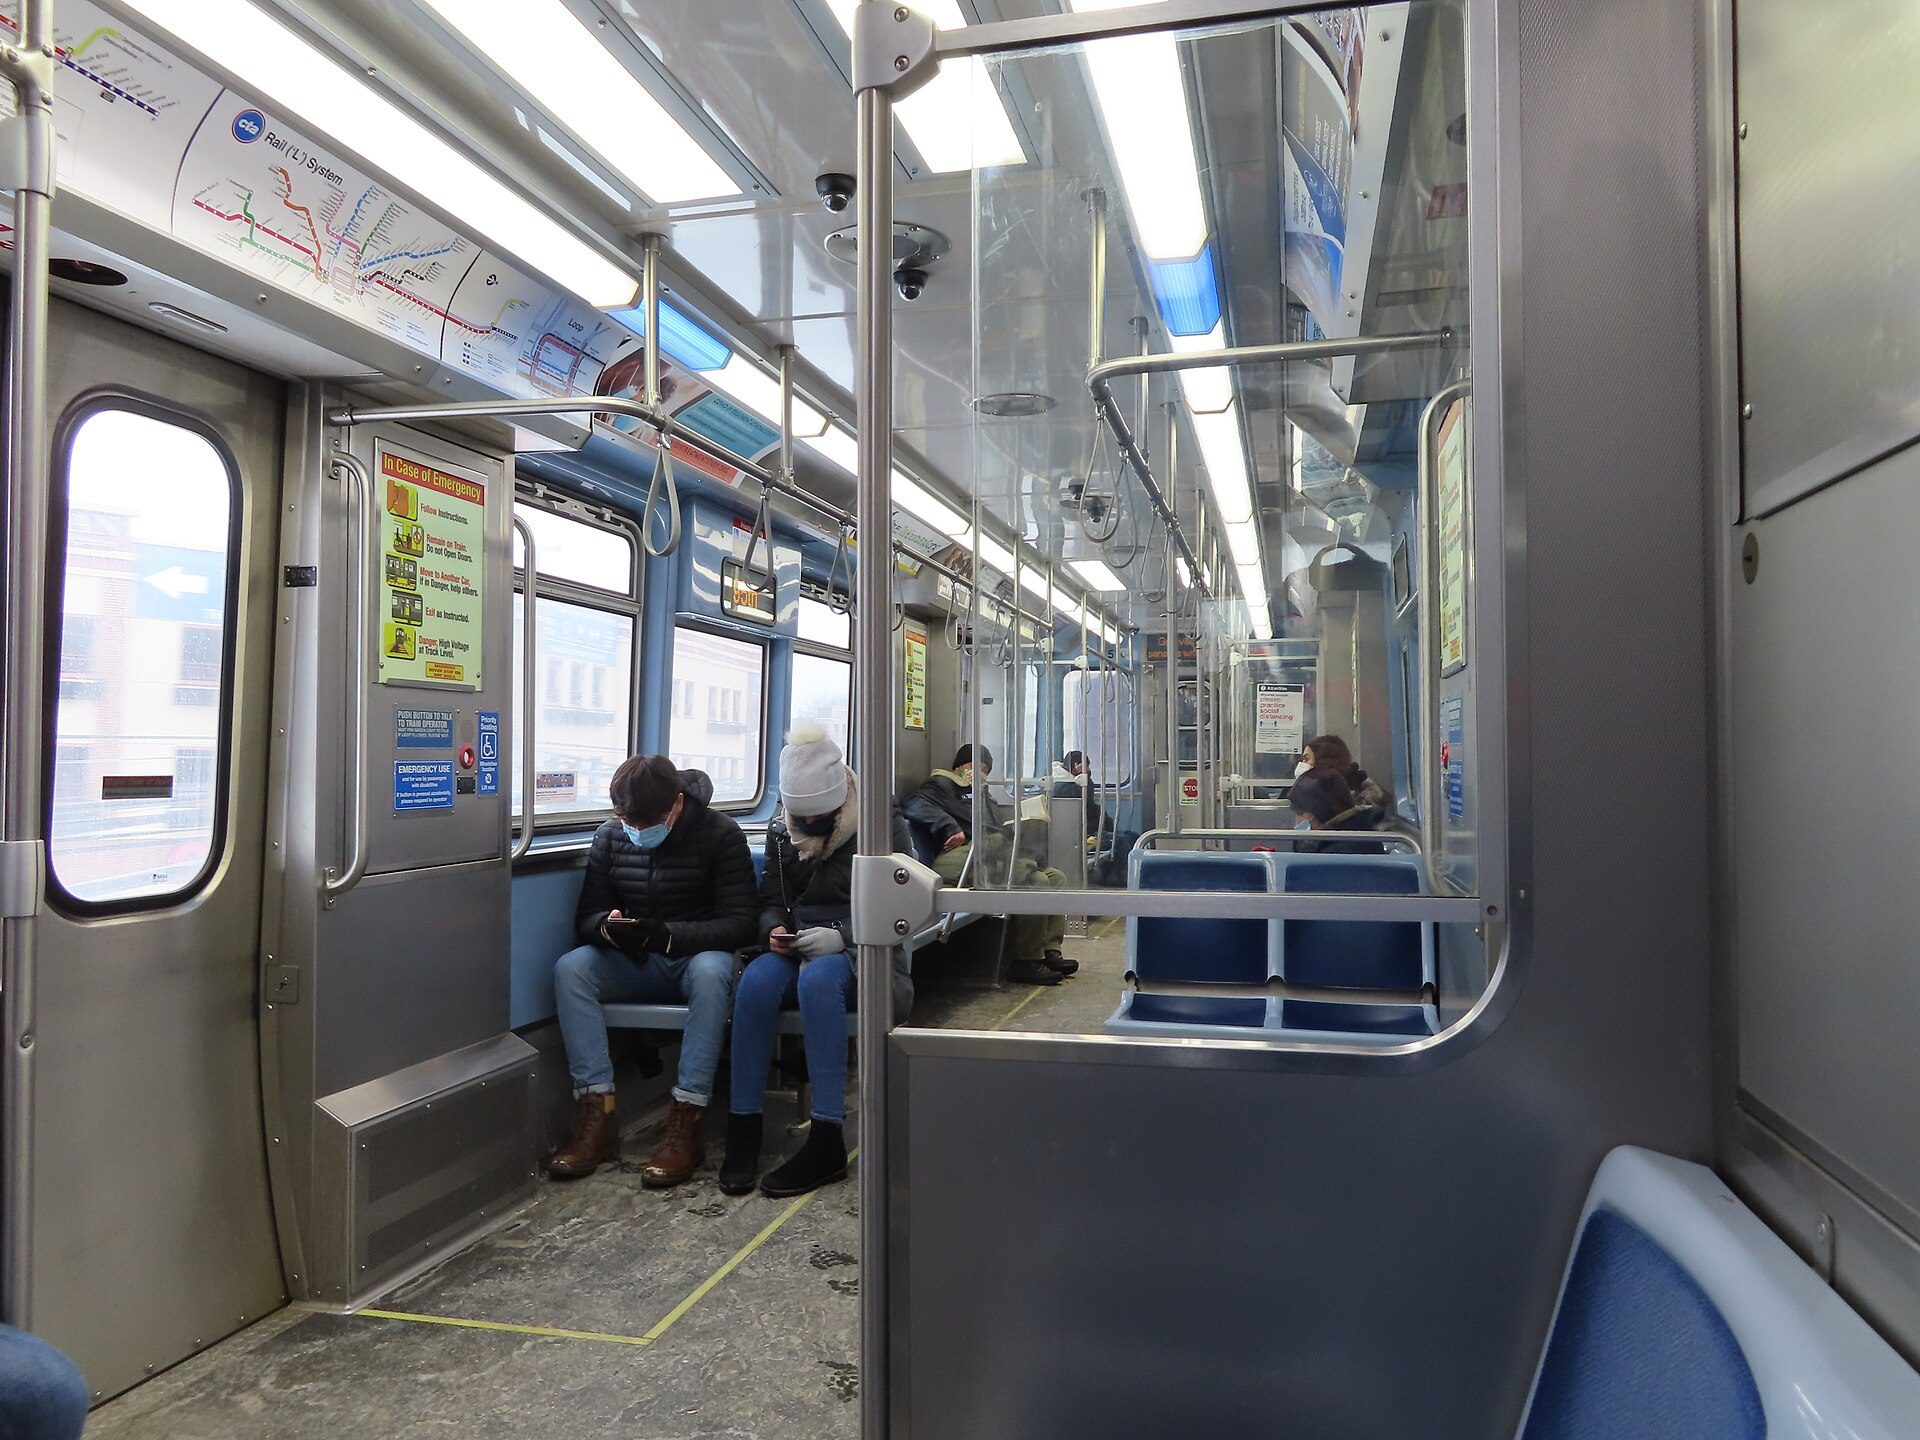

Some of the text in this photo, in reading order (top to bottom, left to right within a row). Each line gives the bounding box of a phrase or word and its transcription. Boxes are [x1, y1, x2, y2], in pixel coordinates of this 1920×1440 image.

[238, 118, 260, 135] cta
[264, 132, 288, 152] Rail
[307, 158, 344, 186] System
[568, 318, 584, 332] Loop
[384, 454, 481, 501] In Case of Emergency
[420, 503, 437, 516] Follow
[426, 534, 446, 546] Remain
[426, 544, 473, 563] Do not Open Doors.
[420, 566, 433, 577] Move
[435, 570, 440, 578] to
[441, 572, 460, 583] Another
[451, 583, 461, 594] help
[426, 607, 435, 617] Exit
[425, 646, 439, 656] Track
[439, 638, 450, 649] High
[451, 640, 469, 652] Voltage
[413, 711, 433, 719] BUTTON
[481, 716, 496, 724] Priority
[481, 724, 497, 732] Seating
[398, 765, 437, 773] EMERGENCY
